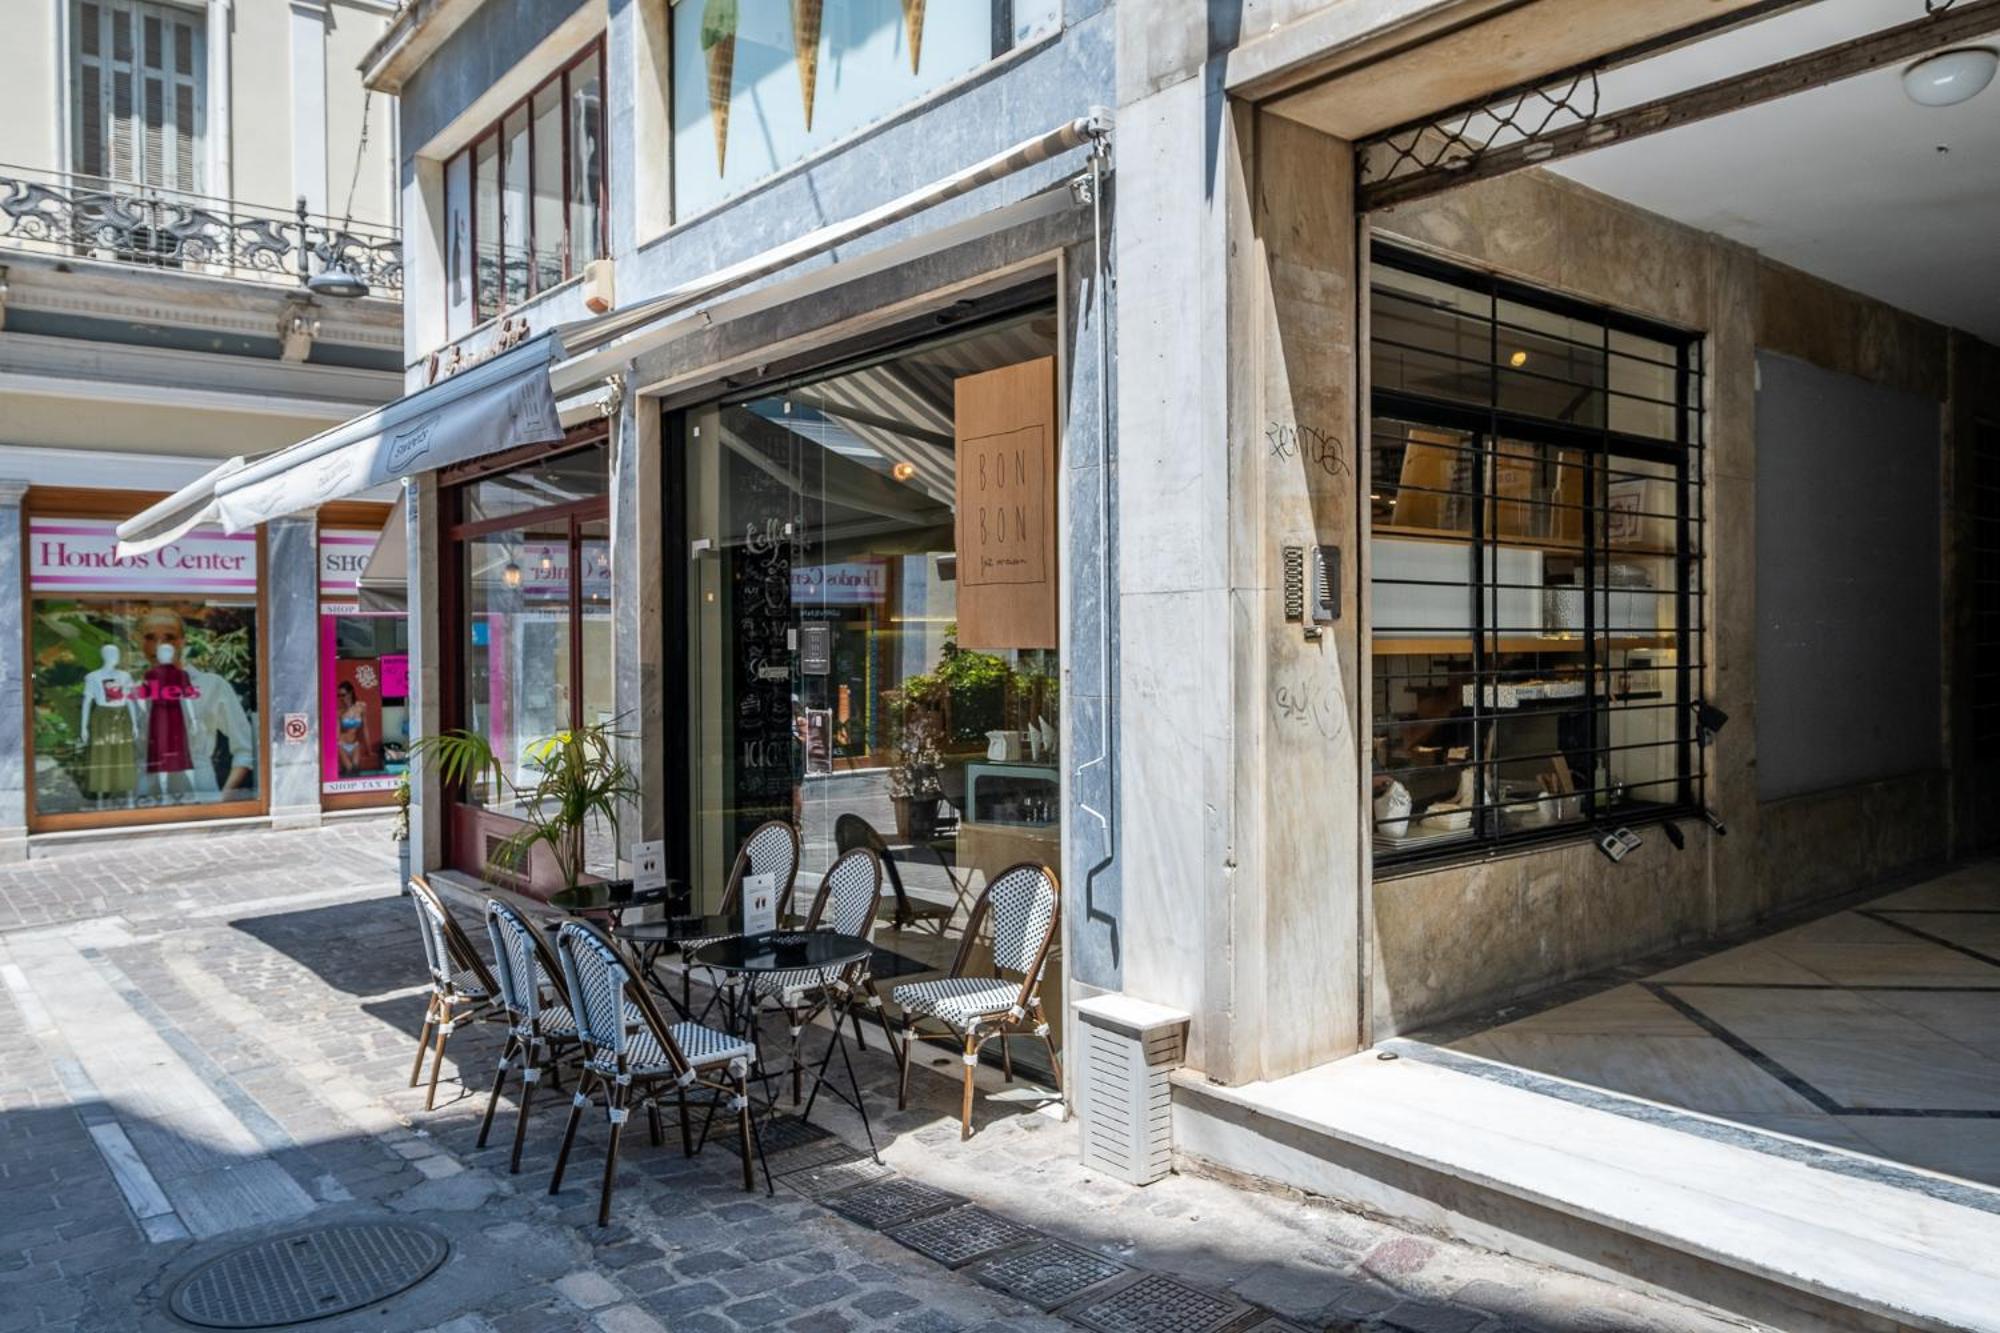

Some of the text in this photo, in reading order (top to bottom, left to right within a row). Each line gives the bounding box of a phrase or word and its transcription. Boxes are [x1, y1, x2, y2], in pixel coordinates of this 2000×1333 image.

[978, 450, 1026, 490] BON
[978, 504, 1027, 545] BON
[40, 541, 246, 570] Hondos Center
